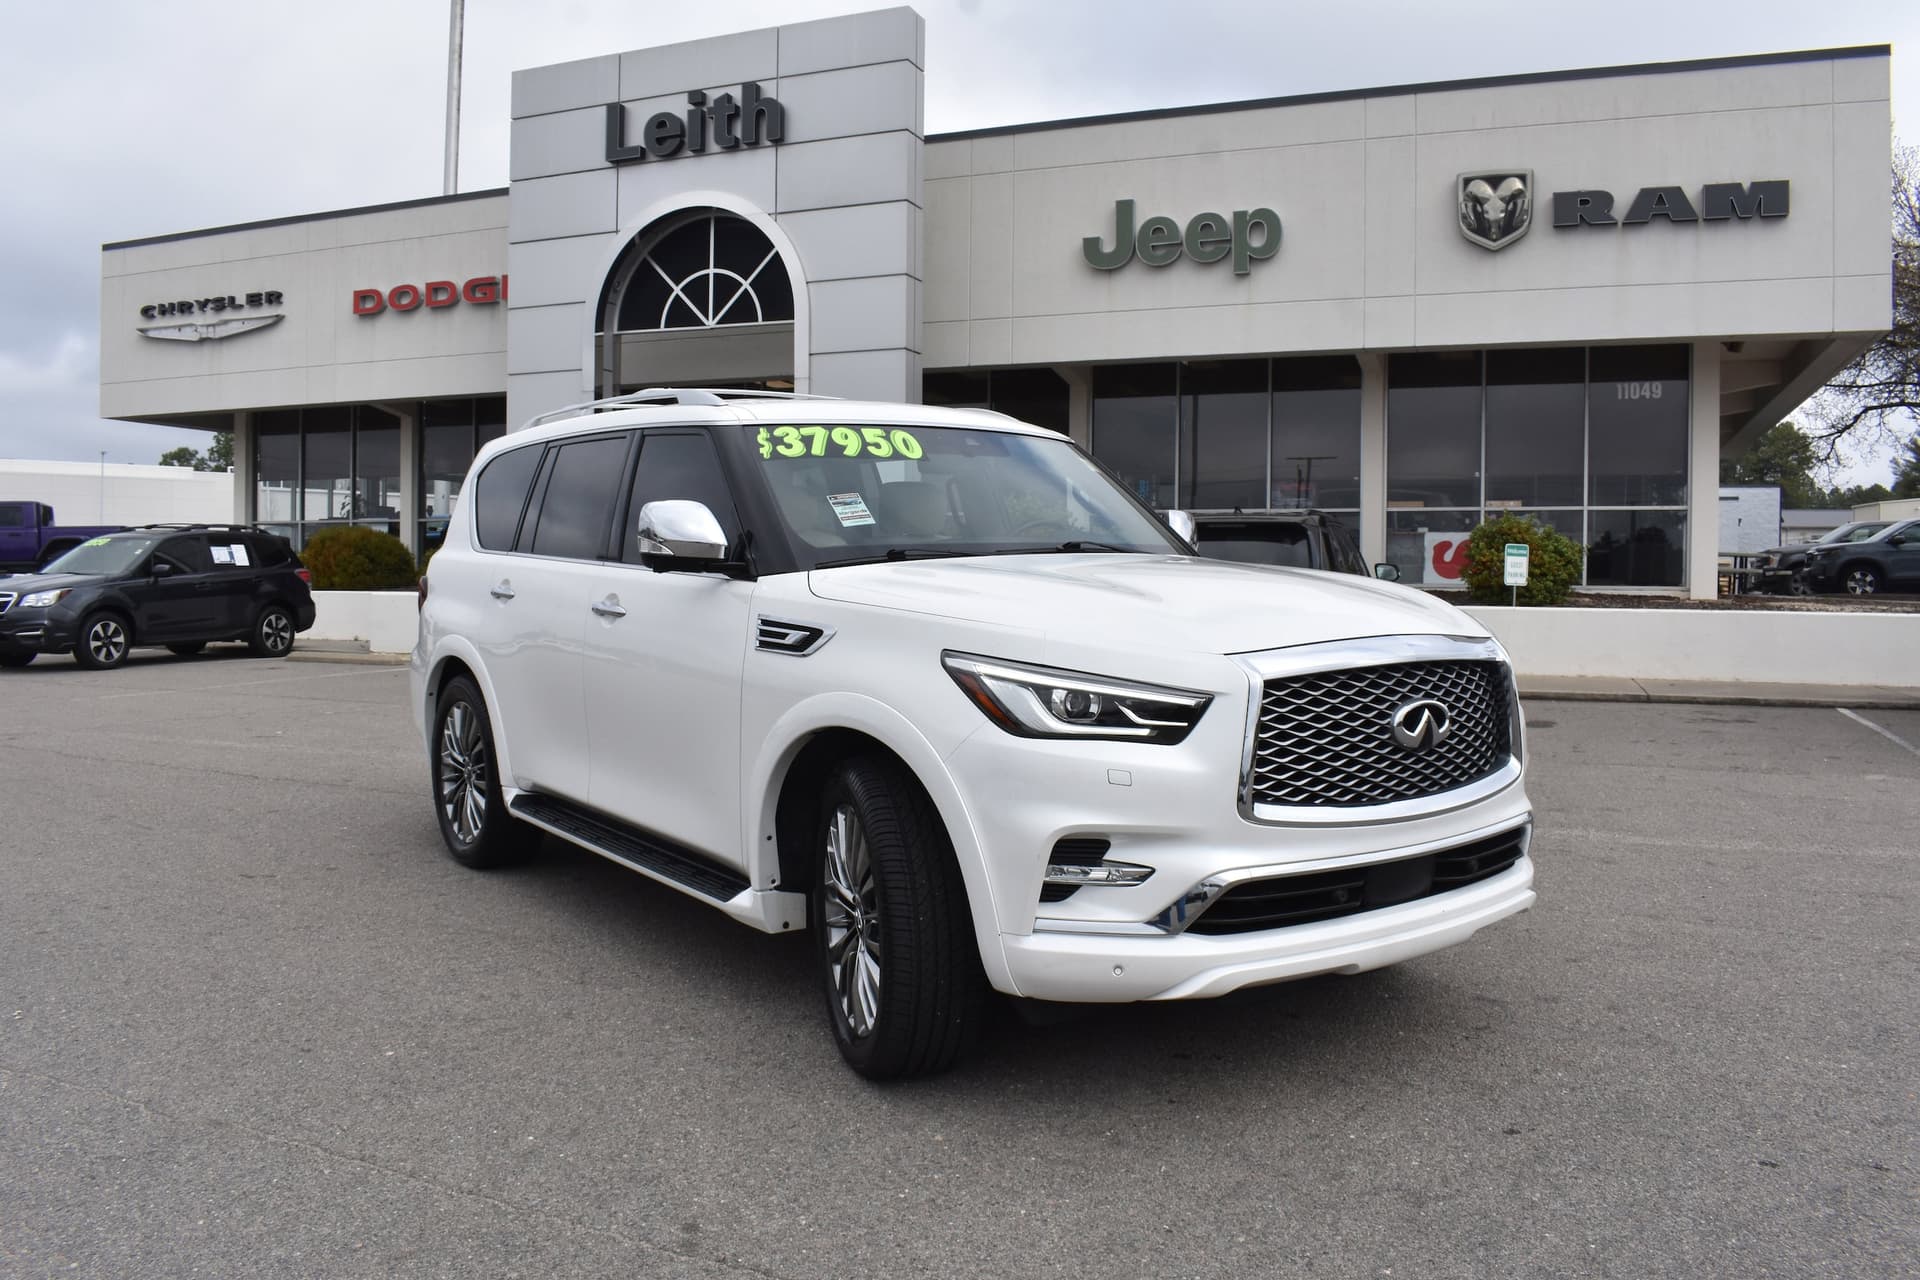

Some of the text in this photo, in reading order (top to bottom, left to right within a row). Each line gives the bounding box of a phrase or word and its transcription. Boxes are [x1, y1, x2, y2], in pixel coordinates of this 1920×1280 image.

[606, 81, 785, 164] Leith
[1553, 180, 1790, 227] RAM
[1082, 199, 1282, 275] Jeep
[140, 290, 283, 319] CHRYSLER
[353, 275, 508, 316] DODG
[1616, 381, 1662, 400] 11049
[757, 426, 923, 459] $37950
